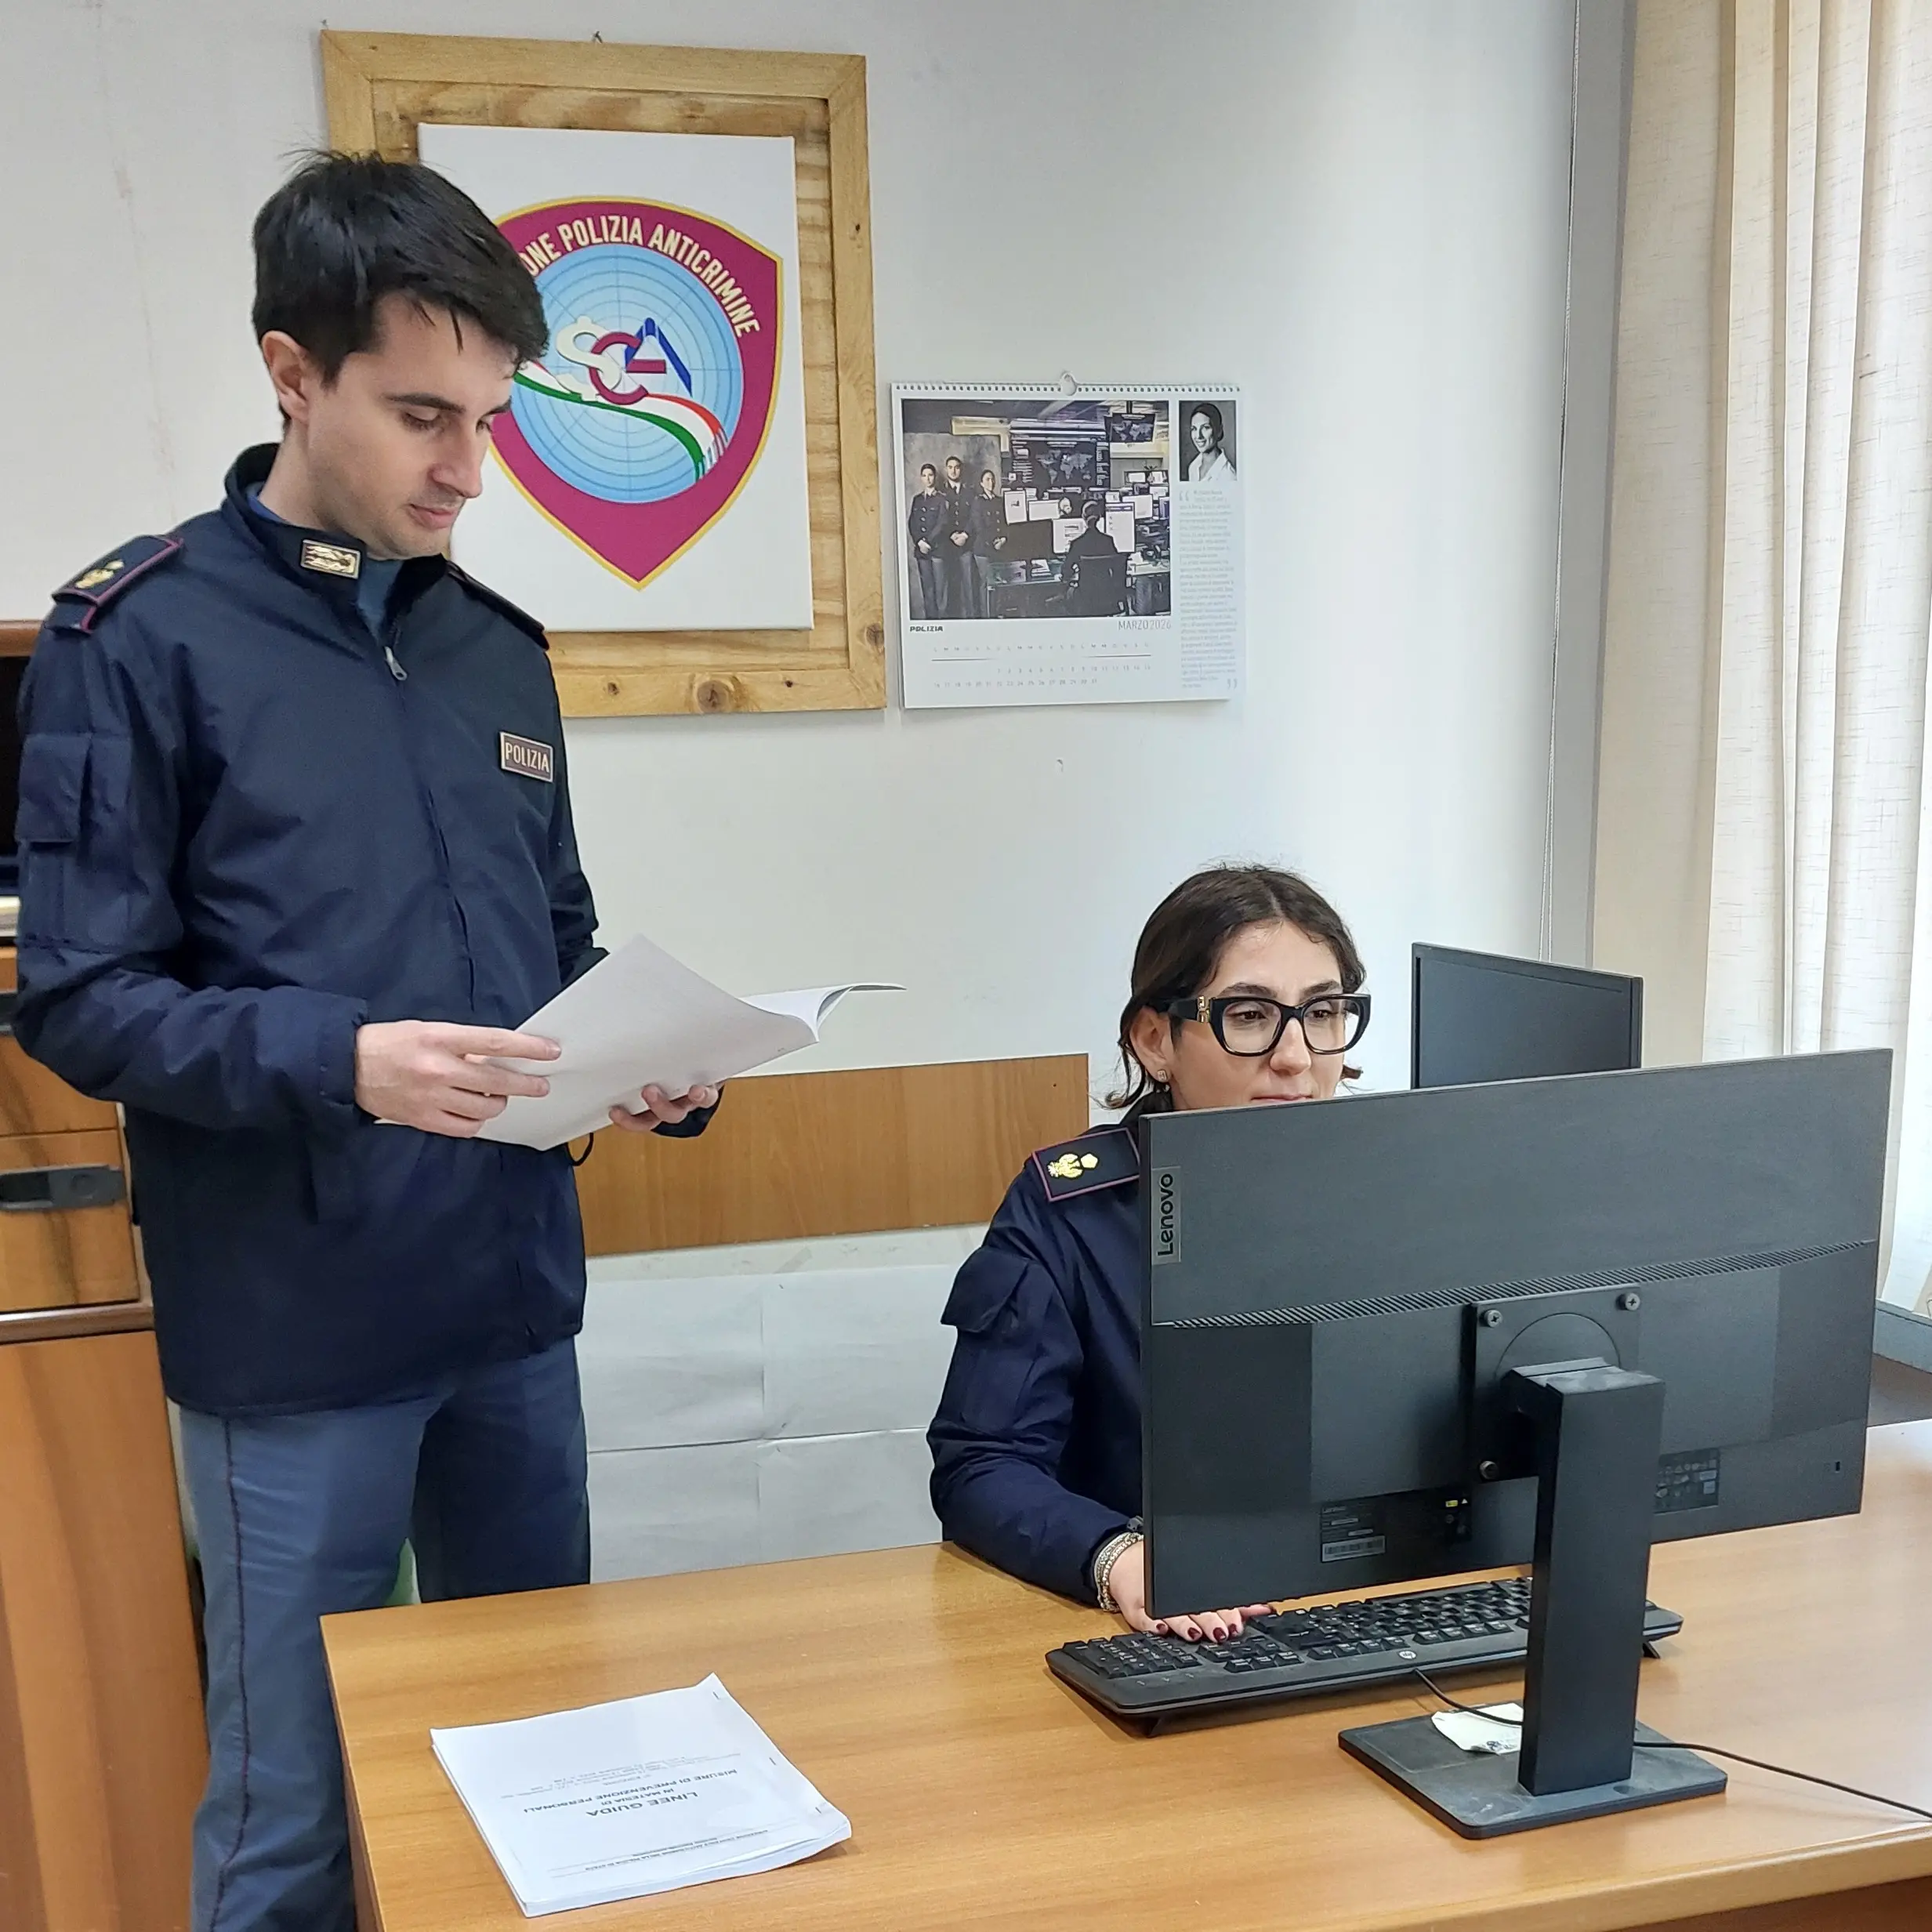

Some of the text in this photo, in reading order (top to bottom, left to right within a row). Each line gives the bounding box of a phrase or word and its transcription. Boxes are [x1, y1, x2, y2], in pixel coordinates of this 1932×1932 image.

[556, 215, 643, 252] POLIZIA
[647, 223, 760, 338] ANTICRIMINE
[1118, 619, 1172, 631] MARZO 2026
[505, 742, 550, 773] POLIZIA
[1157, 1173, 1174, 1256] Lenovo
[679, 1776, 692, 1785] DI
[694, 1768, 738, 1781] MISURE
[595, 1780, 677, 1800] PREVENZIONE
[586, 1792, 698, 1817] LINEE GUIDA
